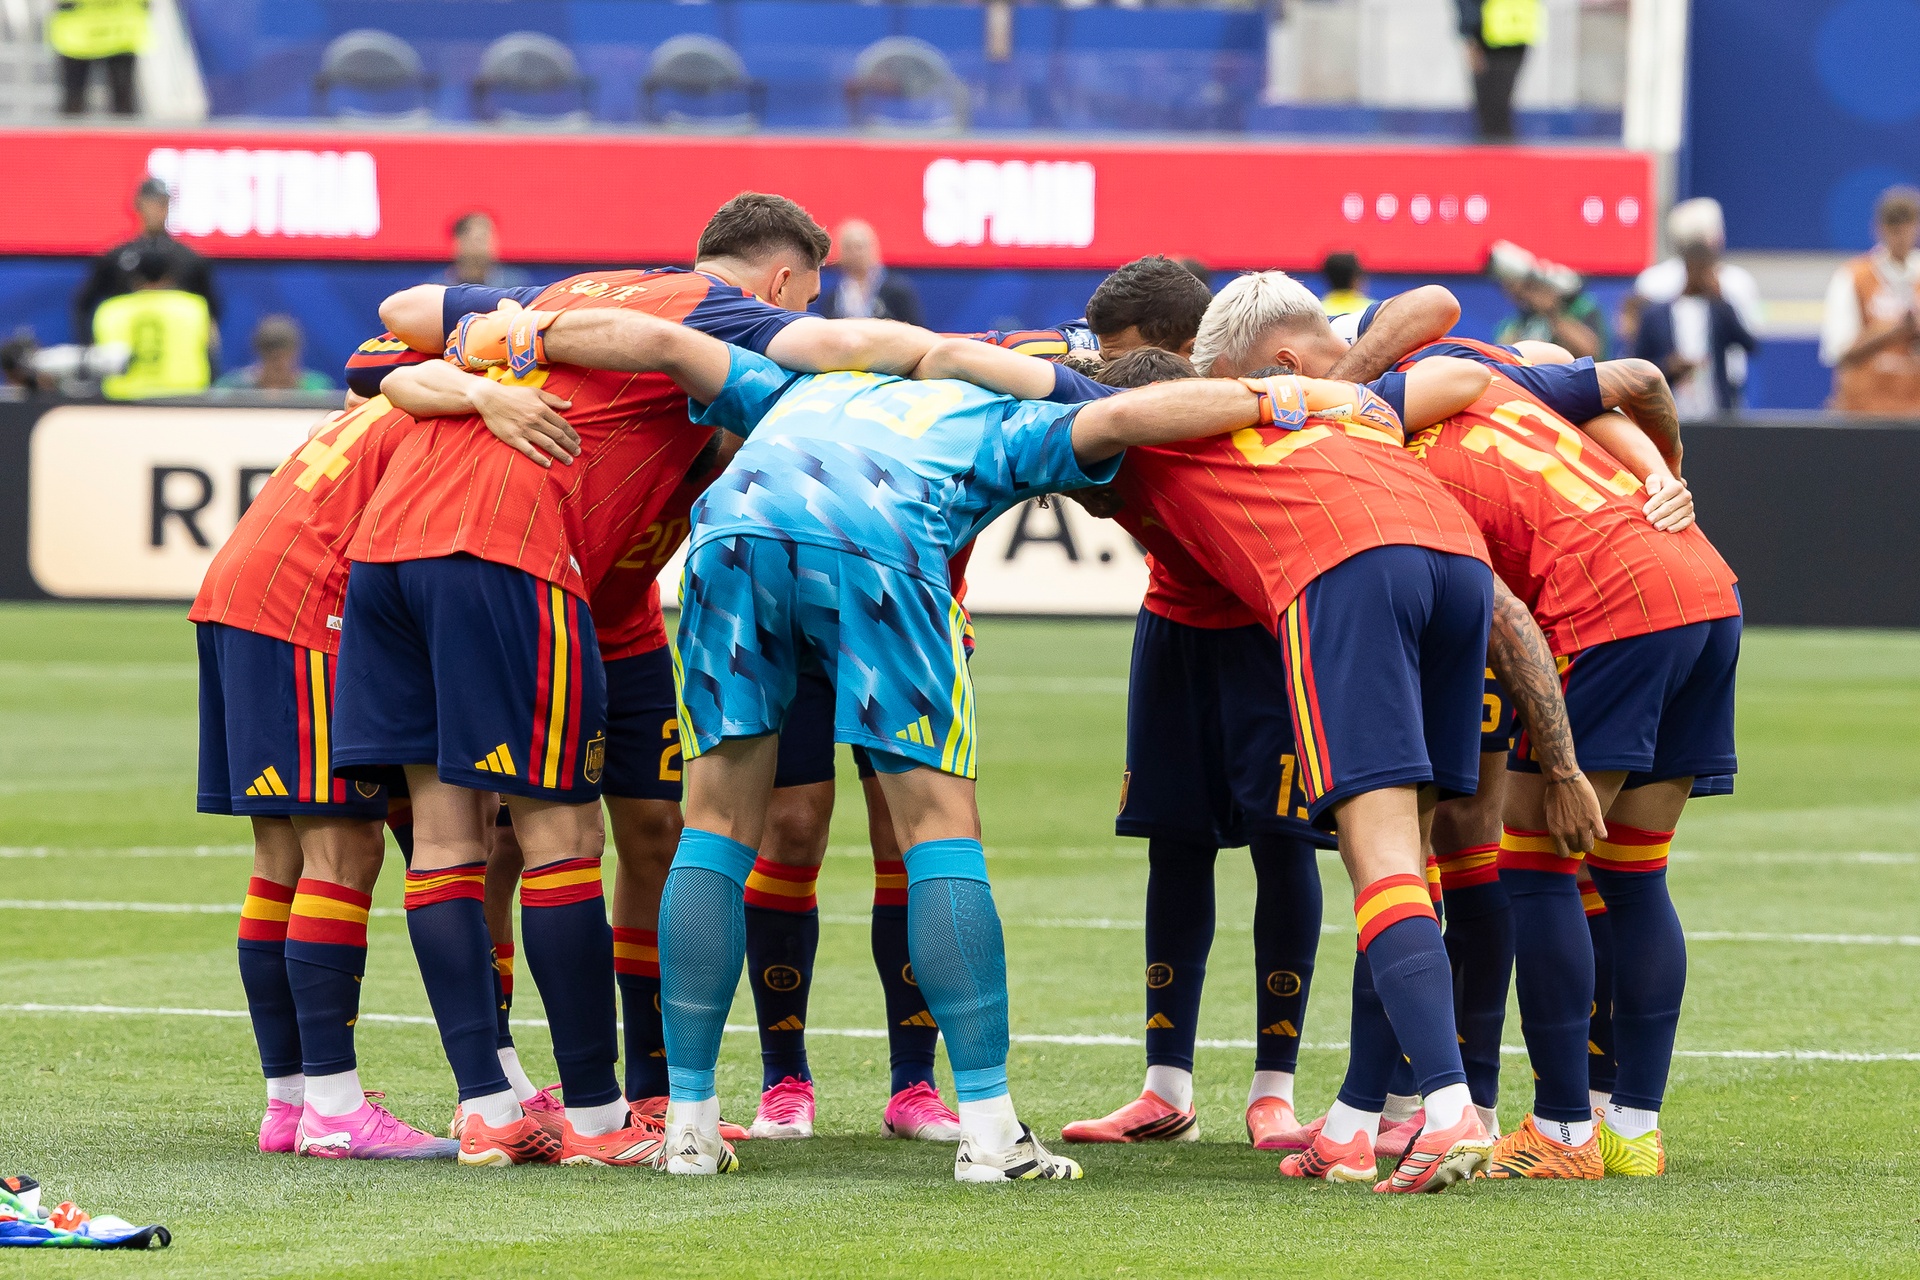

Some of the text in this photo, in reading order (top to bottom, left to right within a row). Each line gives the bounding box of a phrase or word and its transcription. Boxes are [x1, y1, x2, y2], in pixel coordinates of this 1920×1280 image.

[923, 159, 1096, 248] SPAIN
[271, 394, 394, 493] 4
[615, 516, 690, 569] 20
[1559, 1120, 1573, 1146] IGN
